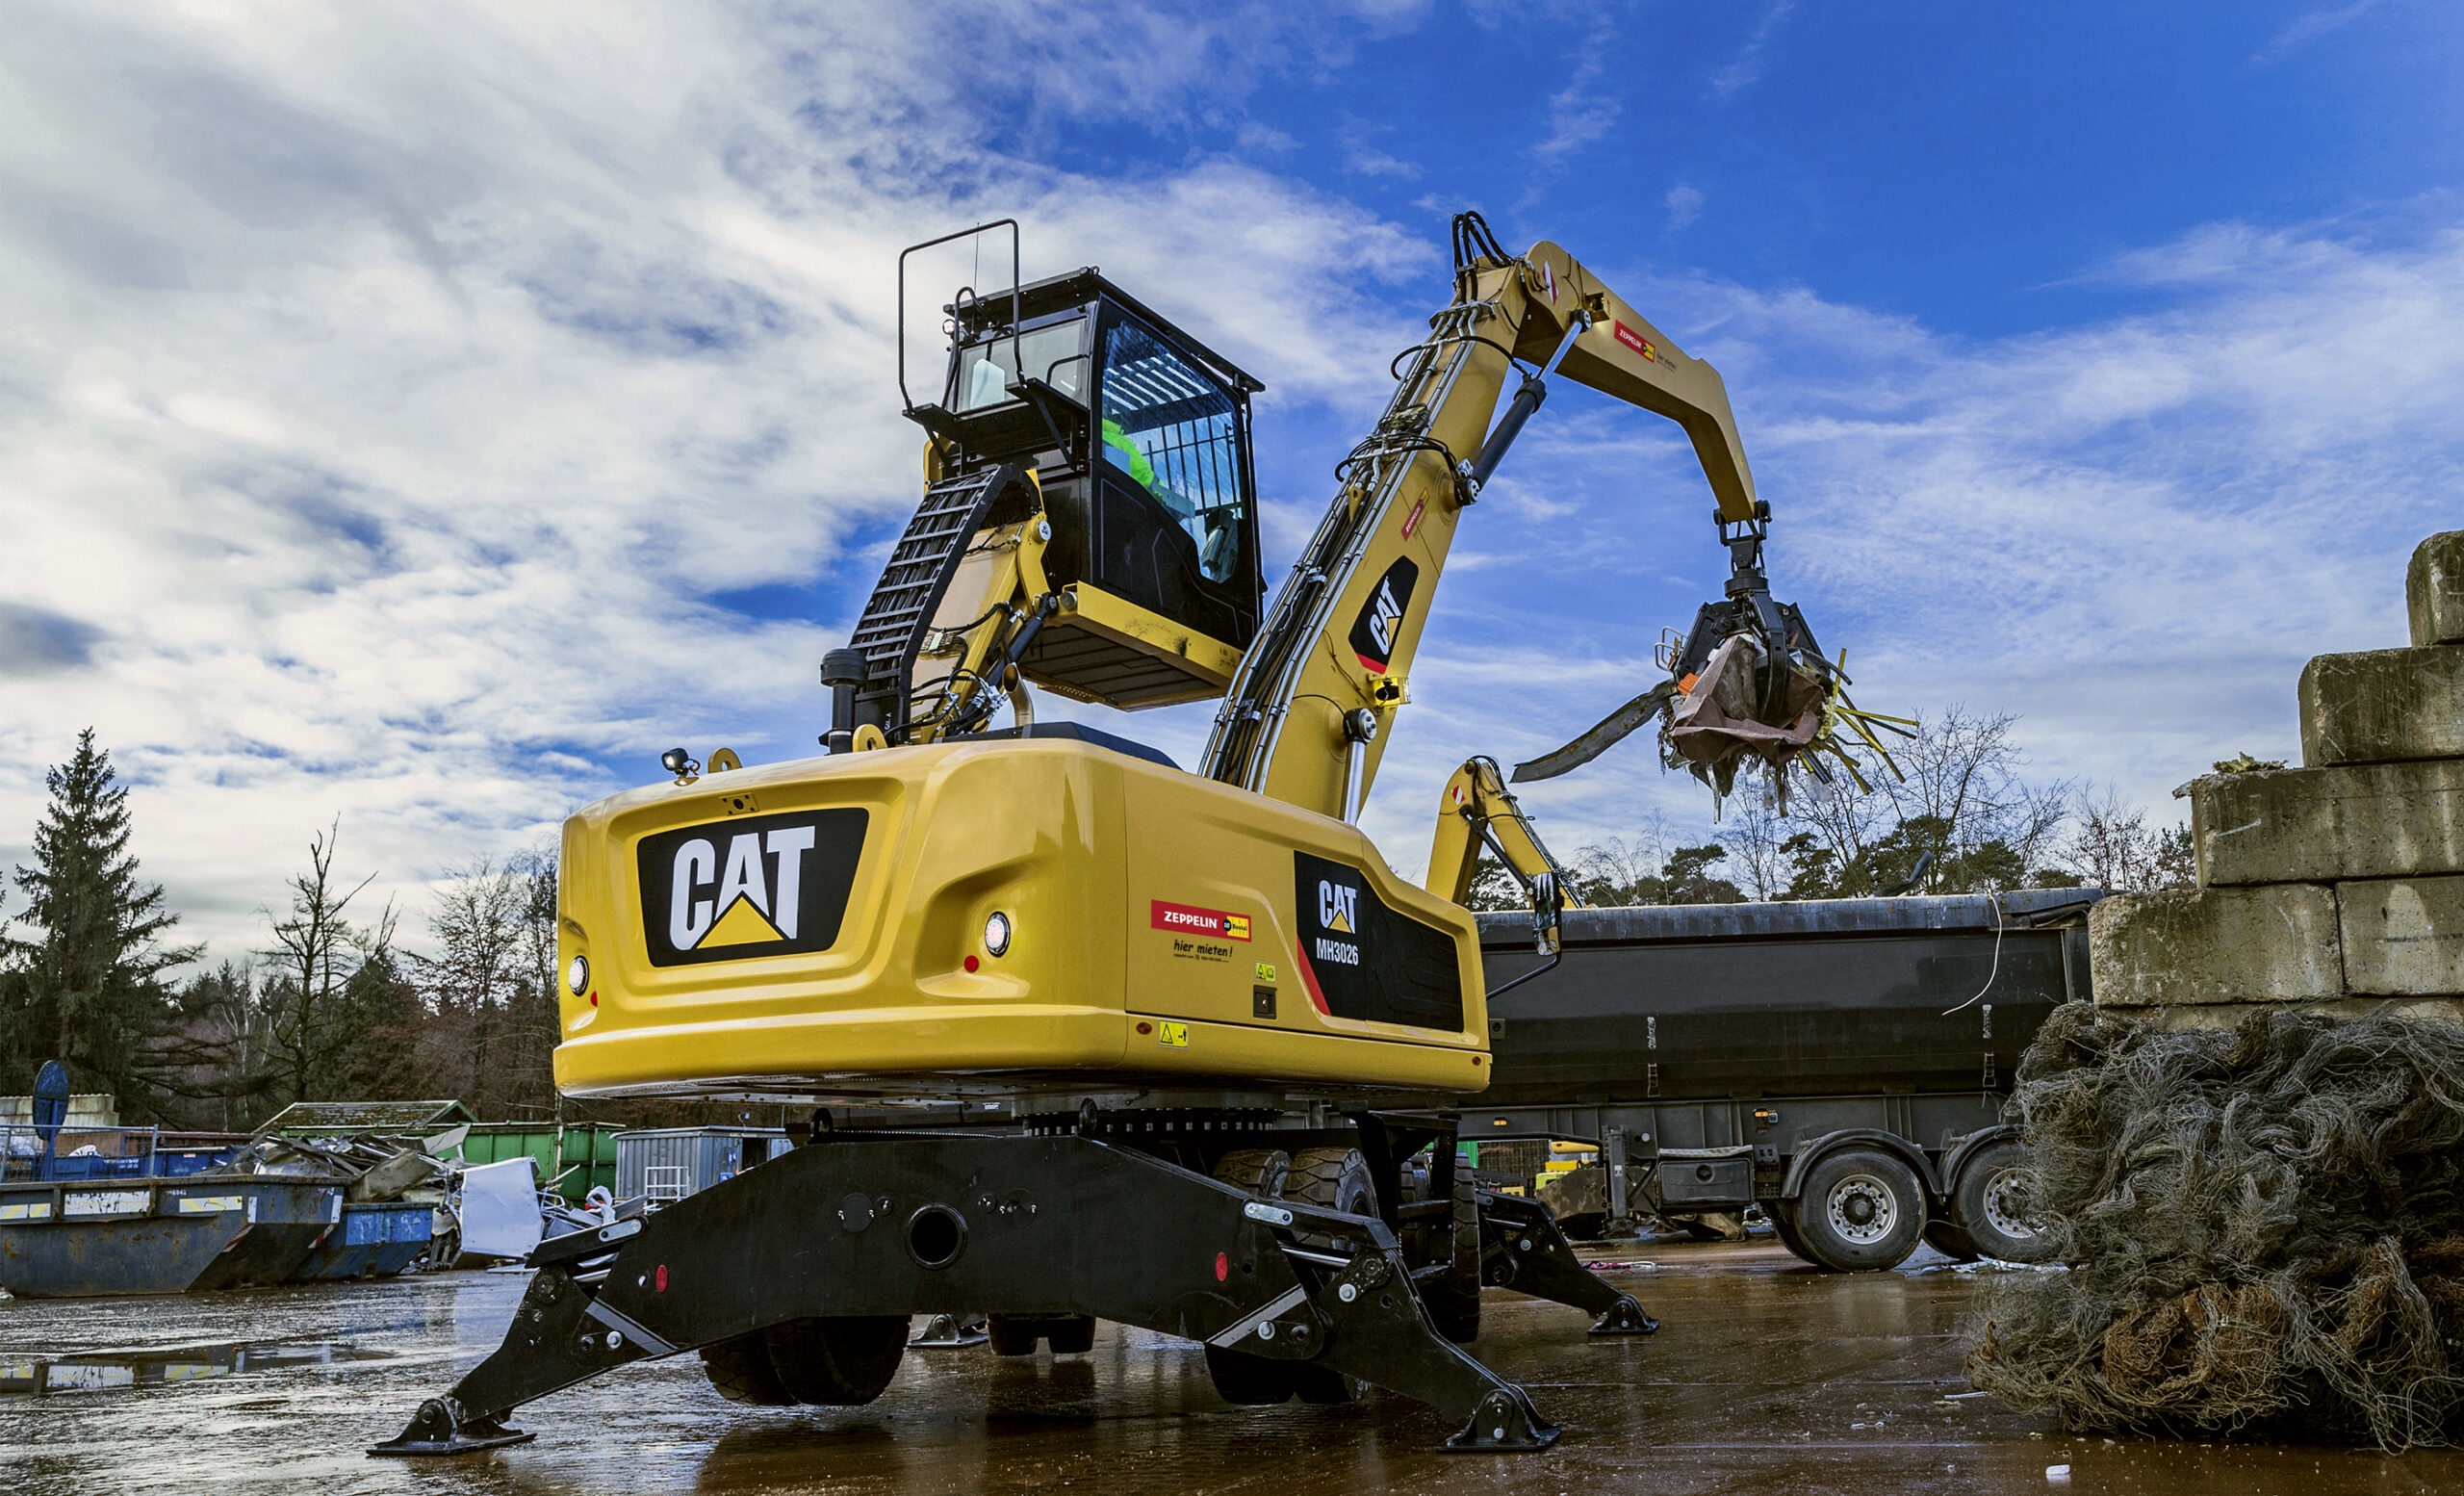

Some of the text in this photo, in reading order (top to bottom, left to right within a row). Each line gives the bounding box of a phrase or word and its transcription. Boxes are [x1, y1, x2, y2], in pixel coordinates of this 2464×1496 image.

[1619, 328, 1641, 348] ZEPPELIN
[1369, 577, 1402, 656] CAT
[669, 825, 815, 951] CAT
[1164, 911, 1218, 929] ZEPPELIN
[1319, 879, 1357, 935] CAT
[1173, 939, 1194, 952] hier
[1316, 937, 1359, 967] MH3026
